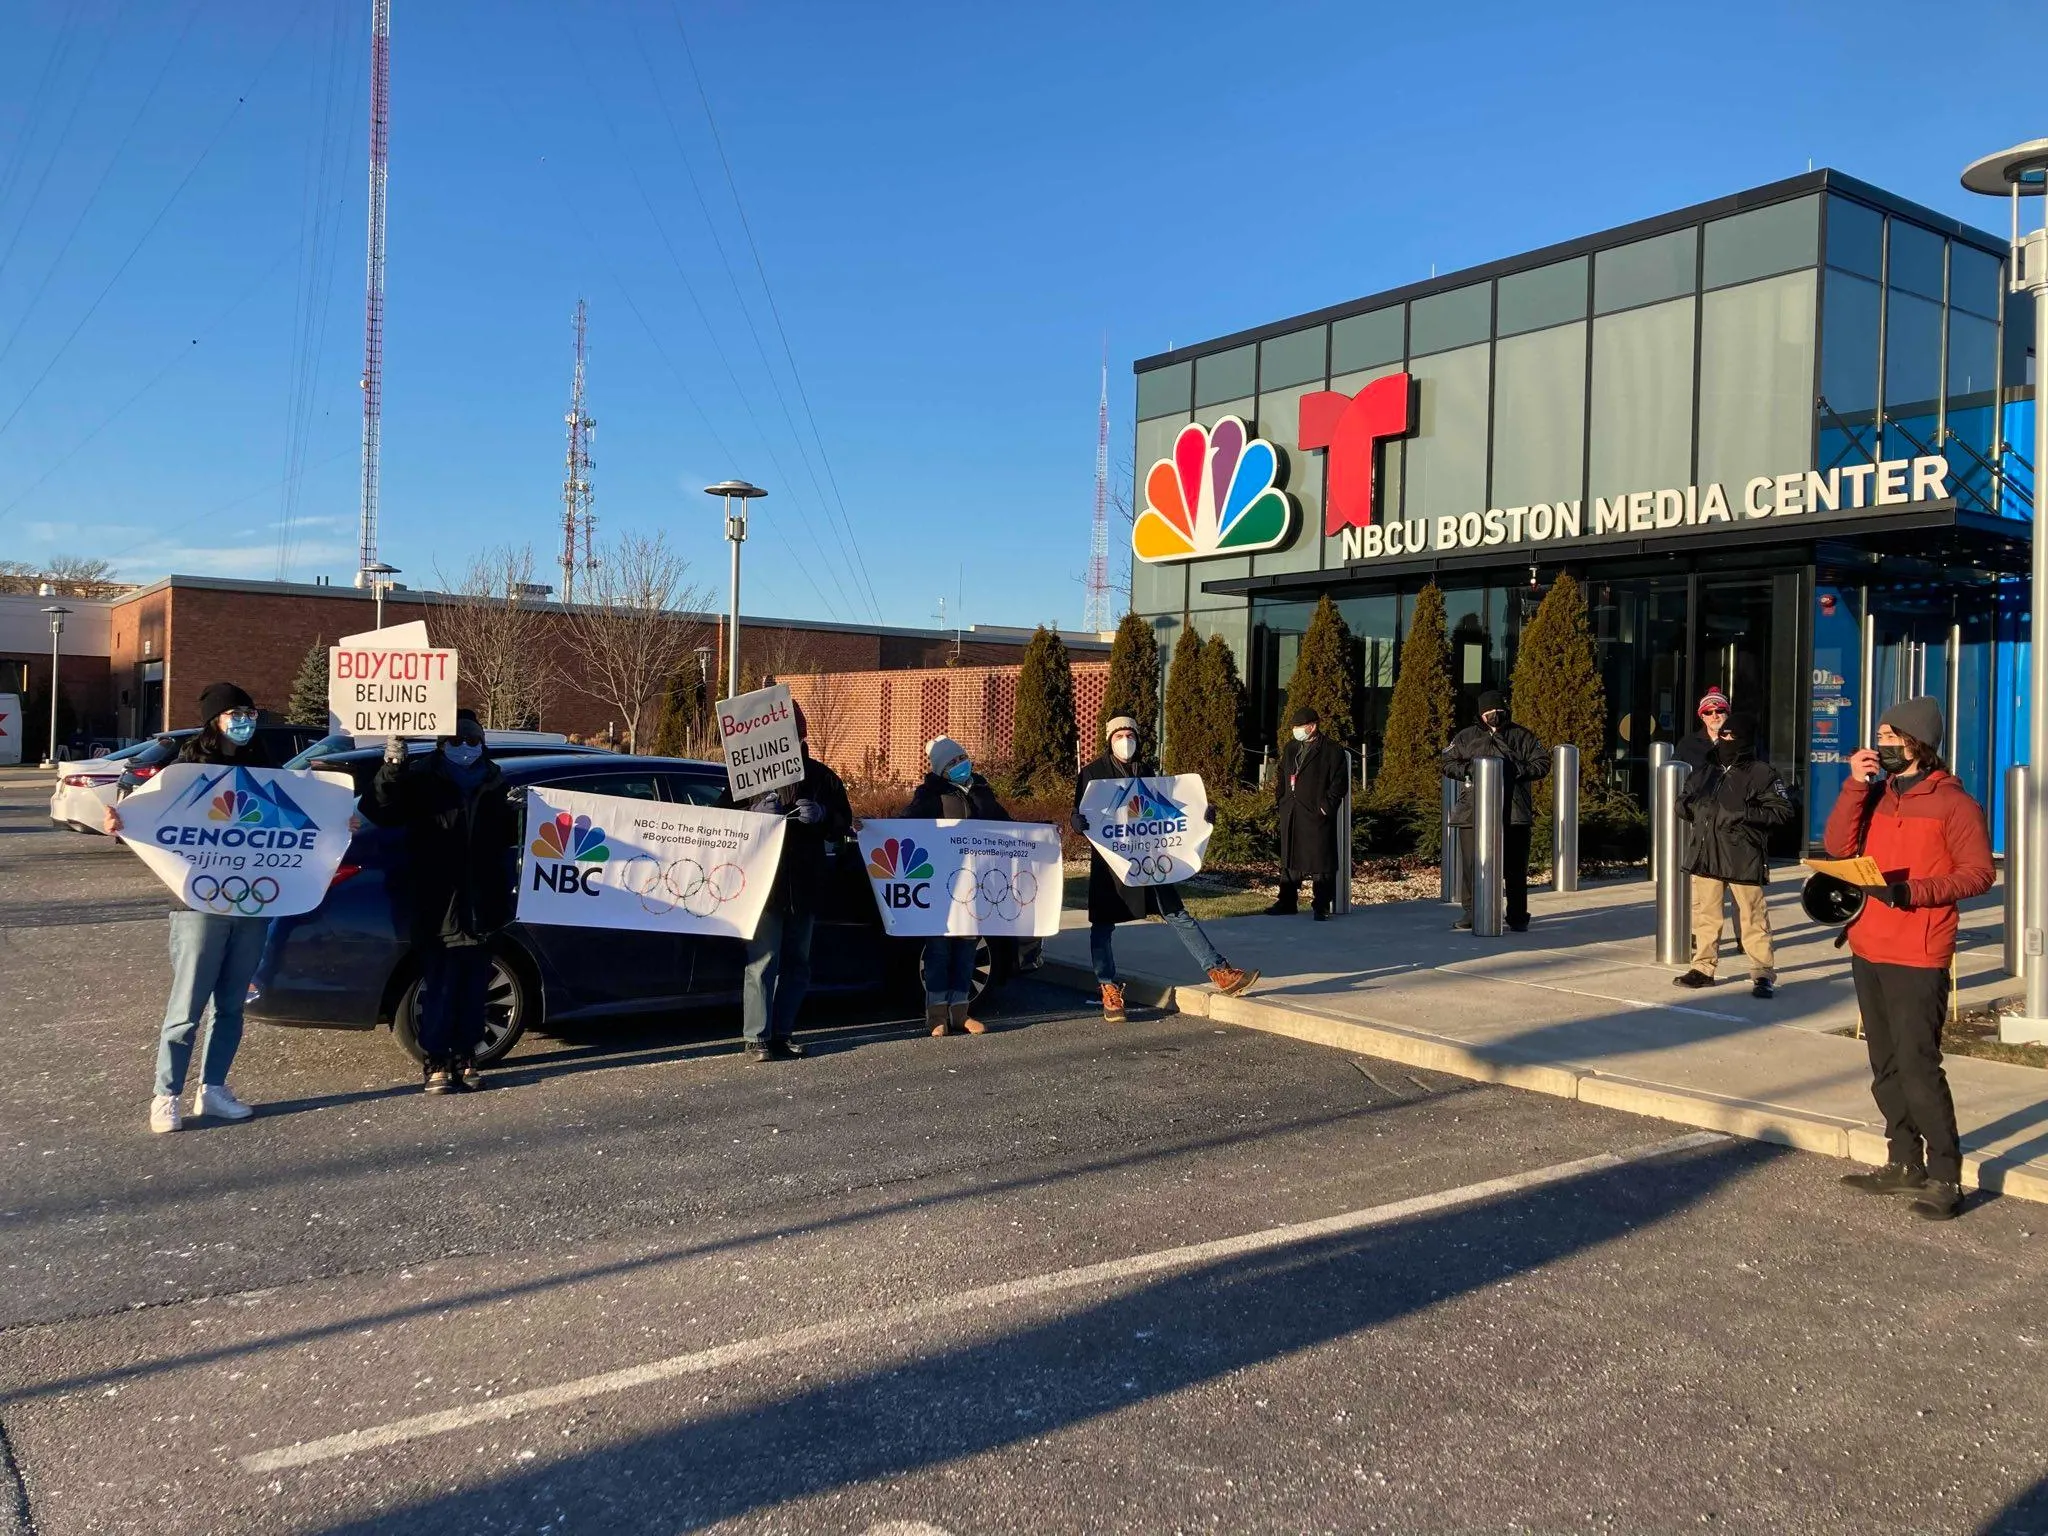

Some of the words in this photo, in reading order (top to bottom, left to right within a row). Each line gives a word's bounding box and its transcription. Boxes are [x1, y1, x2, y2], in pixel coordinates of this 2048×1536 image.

[1342, 518, 1427, 560] NBCU
[1436, 500, 1582, 550] BOSTON
[1595, 482, 1733, 535] MEDIA
[1744, 455, 1950, 519] CENTER
[337, 651, 449, 680] BOYCOTT
[356, 684, 427, 703] BEIJING
[355, 711, 437, 731] OLYMPICS
[721, 700, 789, 737] Boycott
[731, 736, 790, 767] BEIJING
[736, 757, 802, 790] OLYMPICS
[156, 825, 317, 850] GENOCIDE
[634, 819, 659, 829] NBC:
[661, 822, 675, 831] Do
[678, 824, 694, 833] The
[697, 826, 721, 837] Right
[724, 828, 750, 840] Thing
[1102, 819, 1188, 839] GENOCIDE
[642, 832, 738, 849] #BoycottBeijing2022
[950, 836, 970, 845] NBC:
[972, 837, 982, 845] Do
[984, 838, 996, 846] The
[998, 839, 1016, 848] Right
[1018, 840, 1036, 849] Thing
[1112, 840, 1151, 853] Beijing
[1154, 836, 1183, 849] 2022
[252, 853, 303, 868] 2022
[959, 848, 1028, 859] #BoycottBeijing2022
[533, 861, 603, 897] NBC
